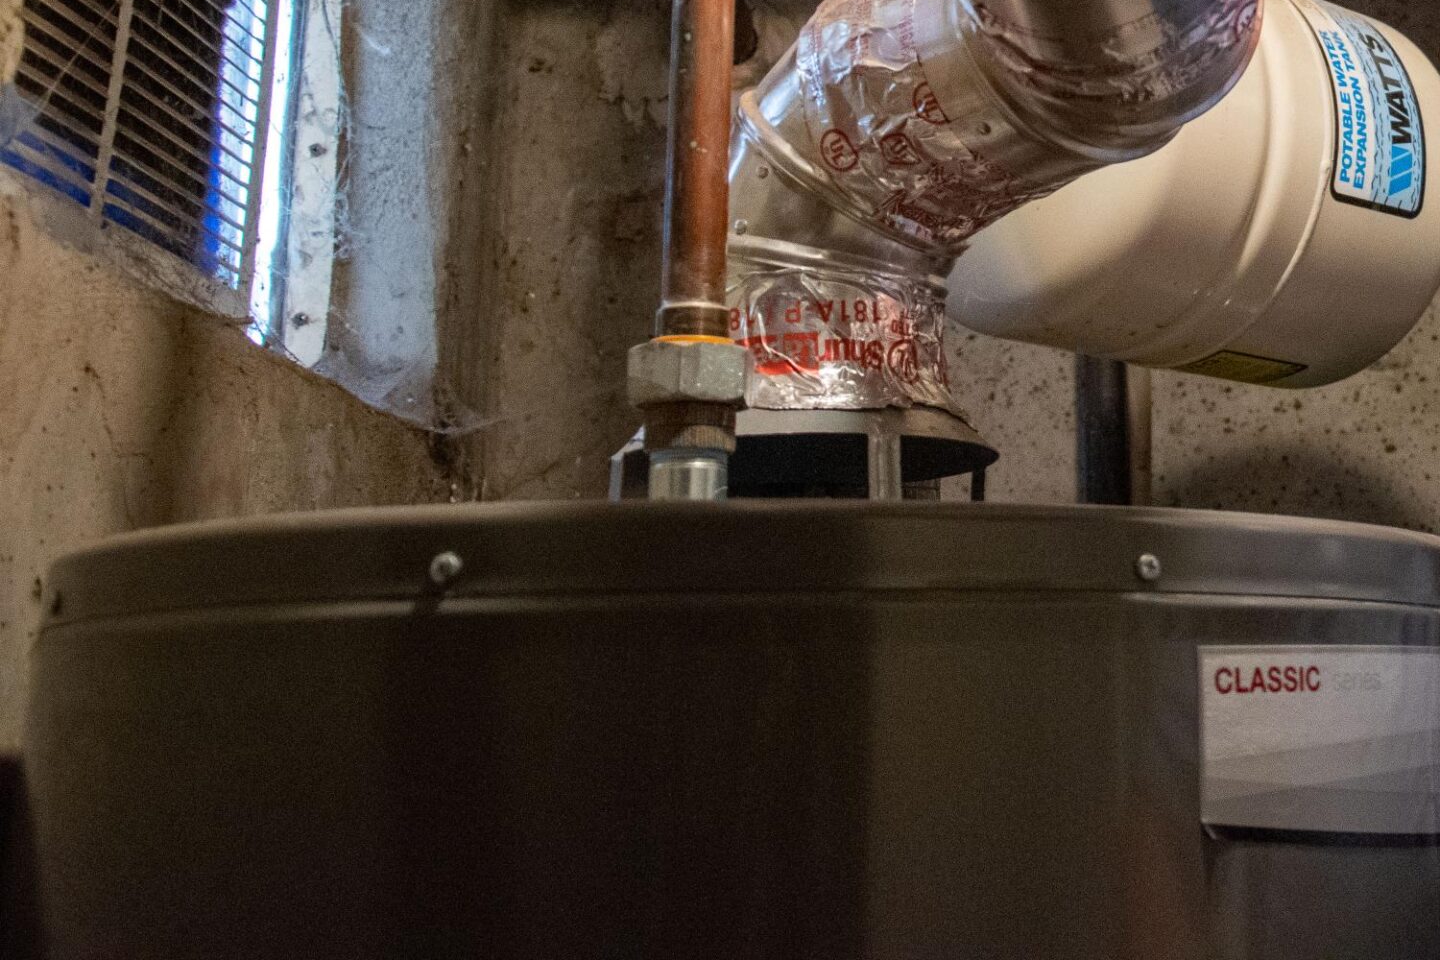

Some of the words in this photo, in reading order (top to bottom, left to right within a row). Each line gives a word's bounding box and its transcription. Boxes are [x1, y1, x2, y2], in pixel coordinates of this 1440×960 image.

[1319, 30, 1347, 87] WATER
[1331, 31, 1356, 72] TANK
[1361, 33, 1413, 145] WATTS
[1339, 91, 1354, 183] POTABLE
[1352, 76, 1368, 189] EXPANSION
[1214, 666, 1321, 695] CLASSIC
